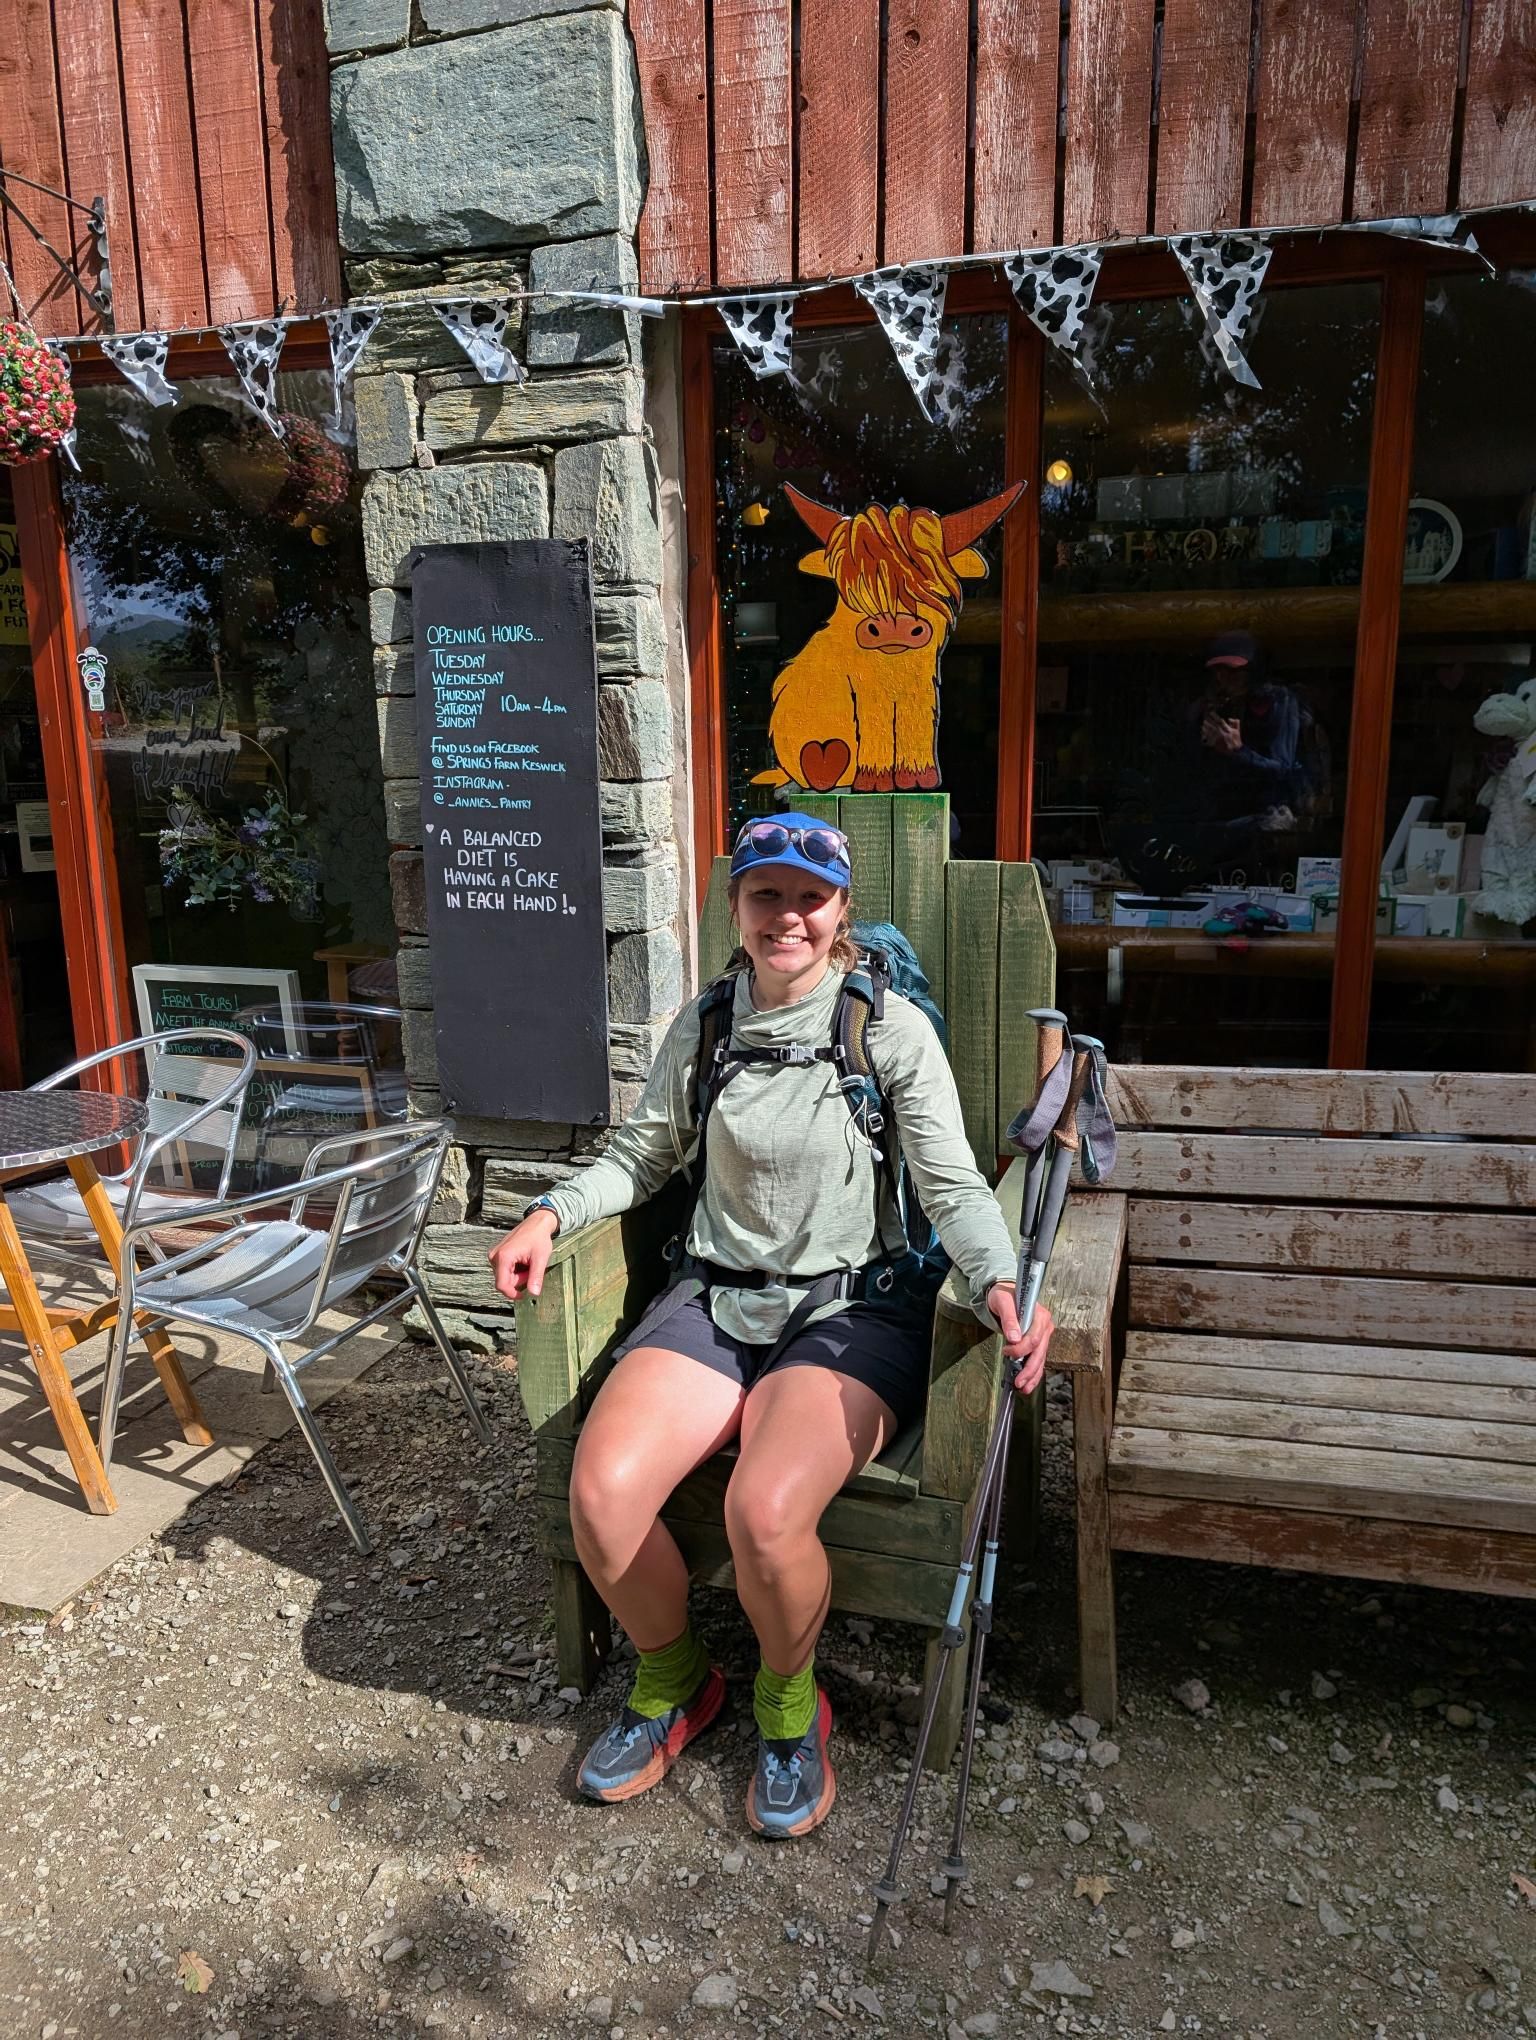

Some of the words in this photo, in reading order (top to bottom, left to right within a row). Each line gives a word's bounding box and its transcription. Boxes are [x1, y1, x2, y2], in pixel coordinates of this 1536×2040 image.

[427, 626, 486, 644] OPENING
[428, 649, 486, 668] TUESDAY
[432, 671, 504, 685] WEDNESDAY
[163, 681, 214, 725] your
[433, 687, 486, 701] THURSDAY
[435, 702, 483, 716] SATURDAY
[146, 729, 179, 747] own
[182, 701, 227, 747] kind
[436, 716, 476, 728] SUNDAY
[430, 736, 456, 753] FIND
[459, 744, 472, 753] US
[473, 744, 486, 753] ON
[487, 740, 540, 754] FACEBOOK
[432, 756, 444, 768] @
[447, 754, 491, 770] SPRINGS
[494, 757, 519, 770] FARM
[522, 758, 566, 772] KESWICK
[132, 745, 153, 801] of
[152, 748, 236, 809] beautiful
[433, 776, 504, 790] INSTAGRAM
[433, 792, 444, 805] @
[440, 829, 452, 846] A
[464, 829, 542, 847] BALANCED
[457, 849, 496, 867] DIET
[504, 852, 518, 867] IS
[444, 867, 496, 886] HAVING
[501, 874, 511, 887] A
[515, 868, 560, 889] CAKE
[446, 892, 461, 908] IN
[467, 891, 505, 911] EACH
[162, 989, 194, 1008] FARM
[155, 1011, 187, 1027] MEET
[187, 1016, 206, 1028] THE
[208, 1019, 245, 1032] ANIMALS
[246, 1023, 259, 1032] ON
